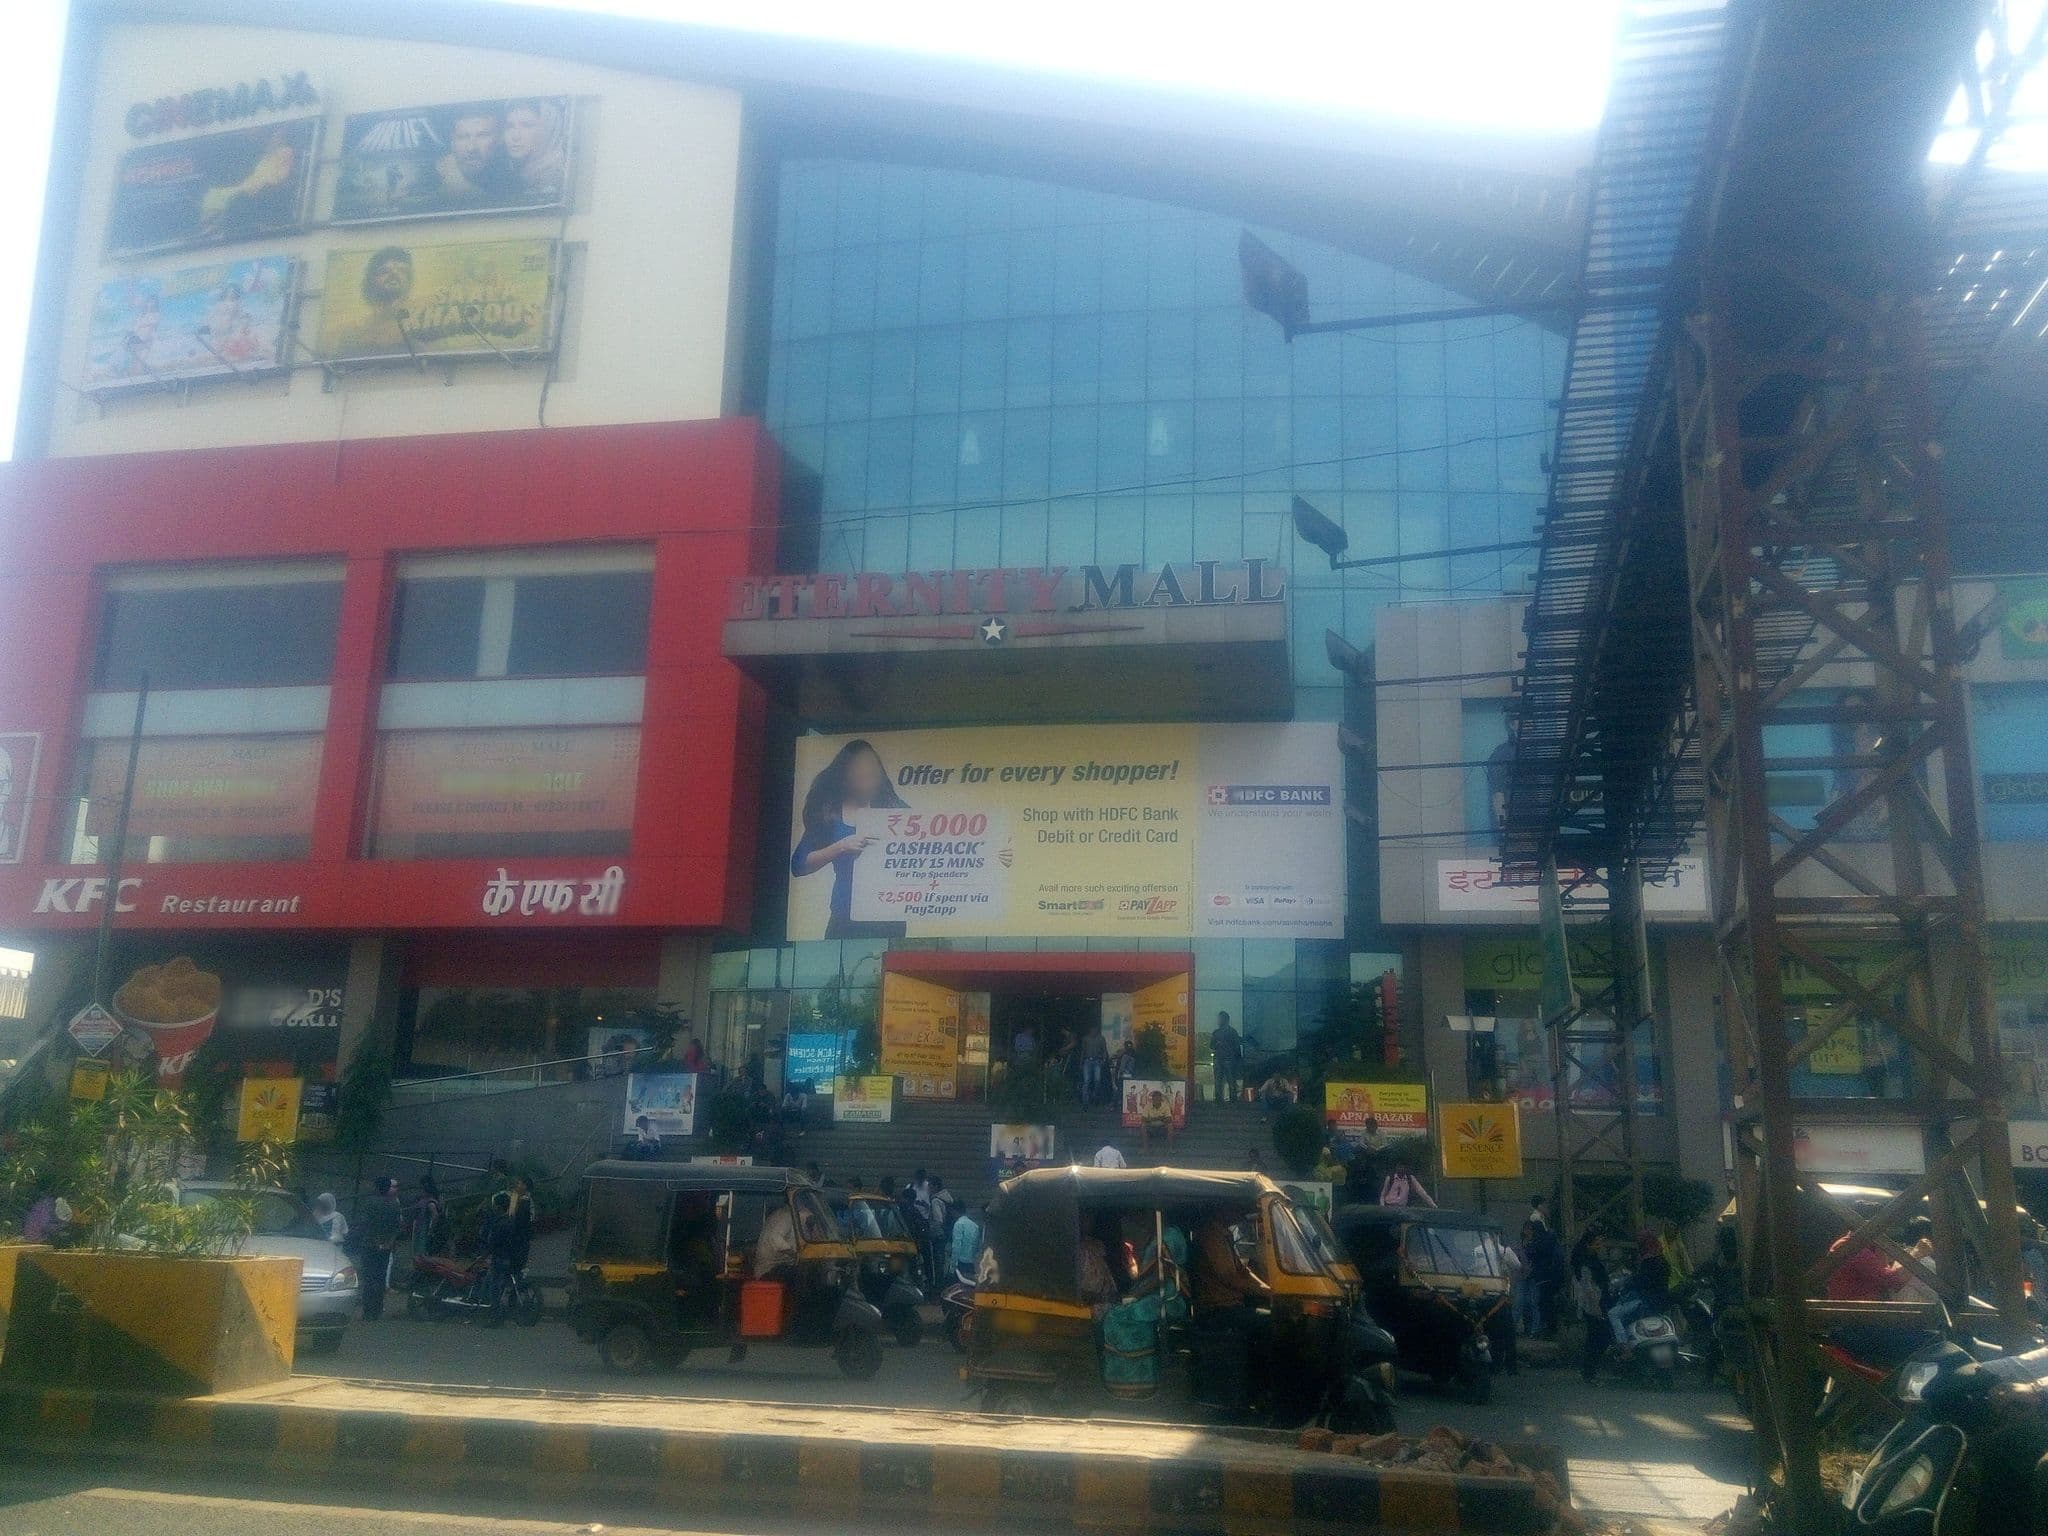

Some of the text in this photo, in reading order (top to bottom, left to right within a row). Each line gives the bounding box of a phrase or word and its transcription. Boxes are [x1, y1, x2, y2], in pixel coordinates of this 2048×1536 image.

[124, 71, 320, 138] CINEMAX
[728, 558, 1286, 621] ETERNITY MALL
[897, 760, 1180, 787] Offer for every shopper!
[1280, 790, 1324, 801] BANK
[1023, 807, 1179, 824] Shop with HDFC Bank
[886, 813, 988, 840] ₹5,000
[1038, 829, 1179, 844] Debit or Credit Card
[884, 857, 985, 870] EVERY 15 MINS
[895, 871, 969, 880] For Top Spenders
[1038, 883, 1059, 893] Avail
[1061, 885, 1082, 893] more
[1084, 883, 1105, 893] such
[1107, 883, 1140, 894] exciting
[33, 878, 299, 915] KFC Restaurant
[924, 892, 934, 903] if
[935, 893, 967, 905] spent
[970, 893, 989, 903] via
[1245, 897, 1265, 905] VISA
[904, 904, 957, 916] PayZapp
[1037, 899, 1104, 911] Smart
[1208, 918, 1223, 926] Visit
[1339, 1111, 1414, 1122] APNA BAZAR
[1459, 1143, 1505, 1153] ESSENCE
